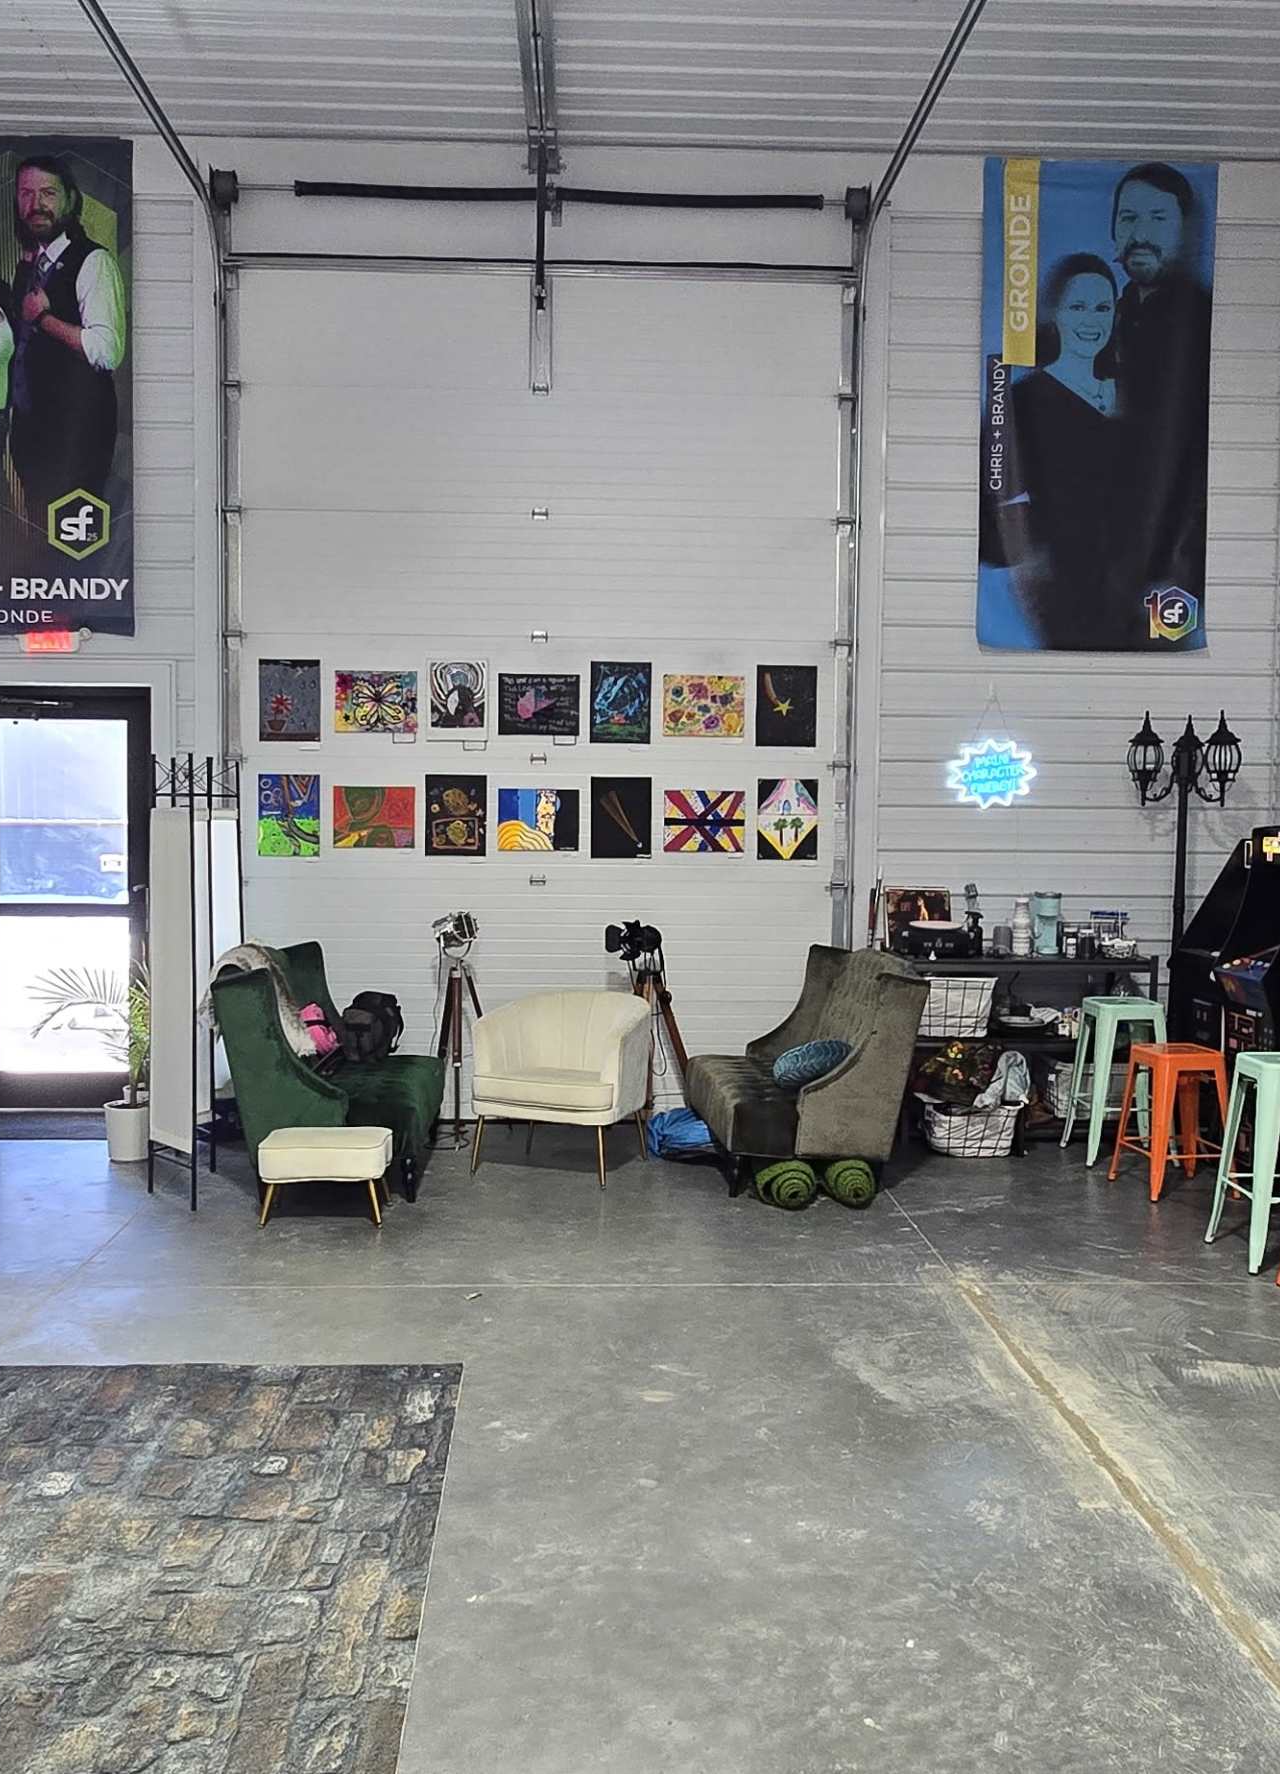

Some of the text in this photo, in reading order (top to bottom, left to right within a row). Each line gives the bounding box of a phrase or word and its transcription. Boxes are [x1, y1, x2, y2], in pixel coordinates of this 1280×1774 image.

[1009, 194, 1032, 332] GRONDE
[991, 358, 1005, 425] BRANDY
[989, 443, 1003, 490] CHRIS
[9, 577, 129, 600] BRANDY
